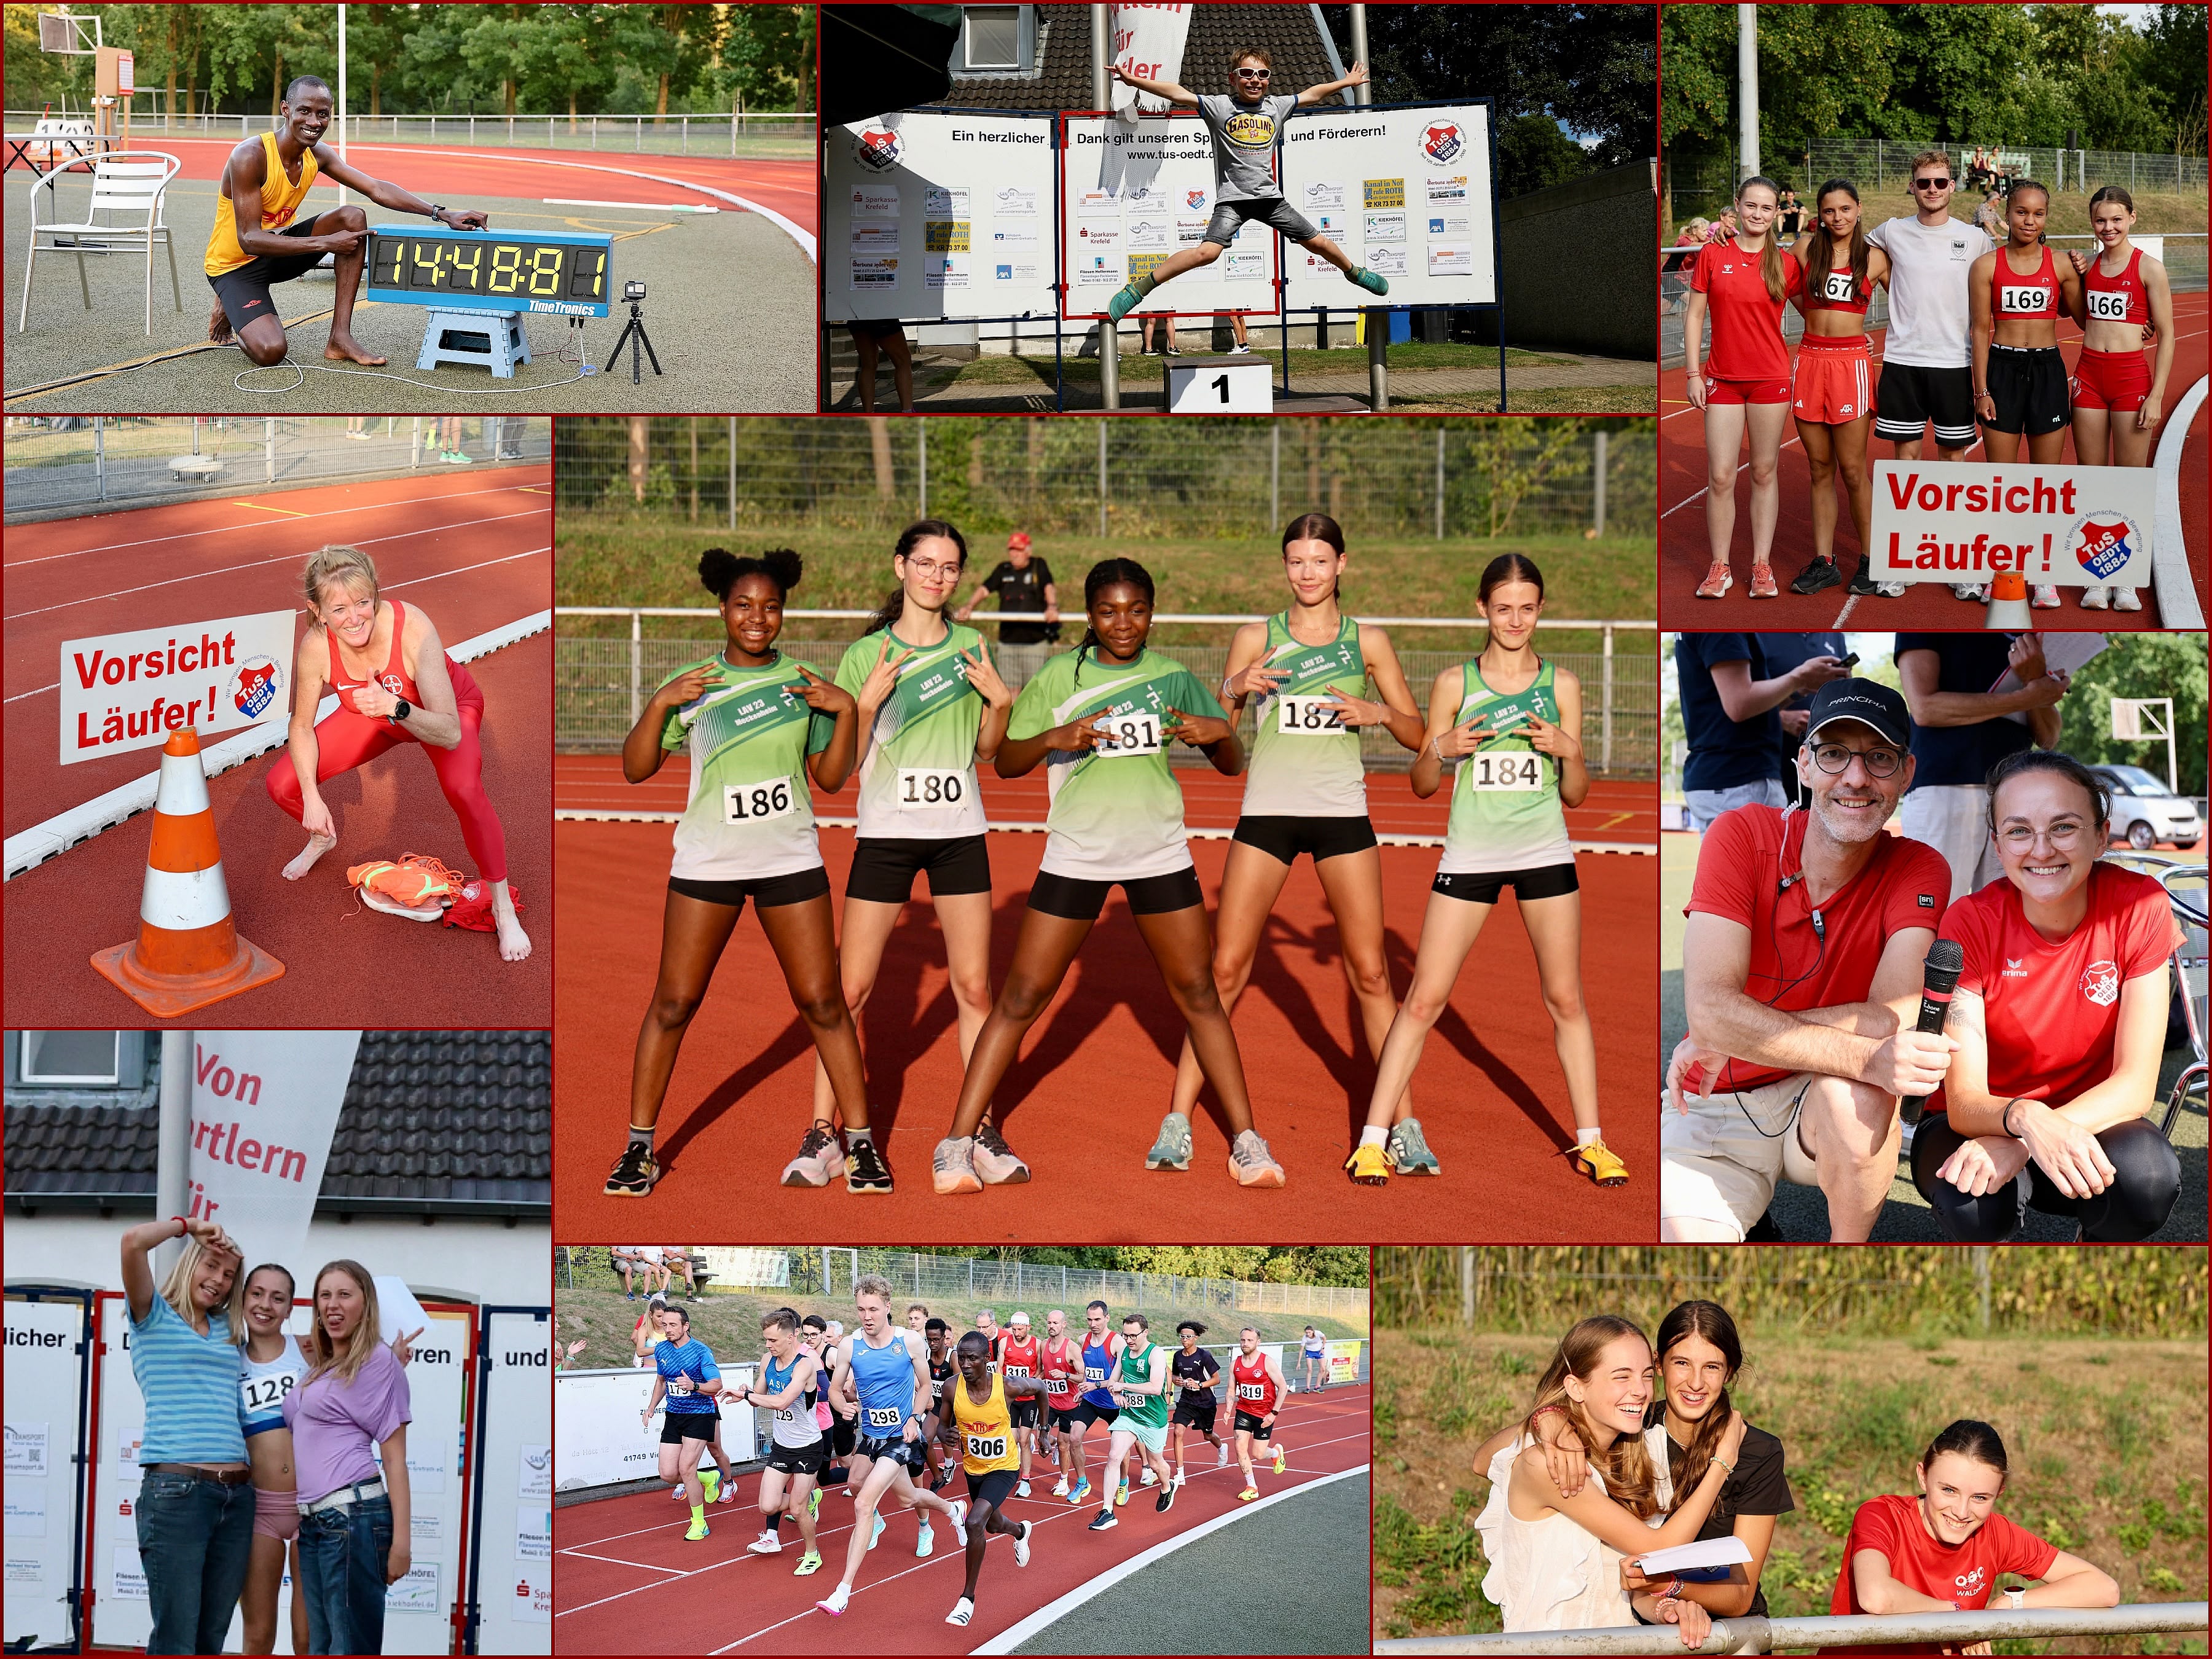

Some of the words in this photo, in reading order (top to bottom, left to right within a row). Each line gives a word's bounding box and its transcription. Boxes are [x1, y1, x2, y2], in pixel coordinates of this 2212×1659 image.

[1229, 118, 1273, 135] GASOLINE
[1291, 129, 1314, 142] und
[1319, 125, 1387, 140] Förderern!
[952, 130, 975, 142] Ein
[978, 130, 1046, 144] herzlicher
[1077, 133, 1109, 144] Dank
[1113, 133, 1134, 146] gilt
[1138, 134, 1190, 144] unseren
[1429, 132, 1449, 149] TuS
[1437, 138, 1454, 154] OEDT
[871, 144, 892, 160] OEDT
[876, 151, 896, 166] 1884
[1441, 144, 1459, 159] 1884
[1826, 277, 1853, 298] 67
[528, 300, 595, 316] TimeTronics
[2005, 290, 2045, 310] 169
[2090, 294, 2124, 316] 166
[1211, 374, 1230, 404] 1
[1886, 473, 2077, 516] Vorsicht
[2069, 517, 2085, 538] bringen
[2085, 509, 2122, 519] Menschen
[2129, 519, 2143, 552] Bewegung
[2082, 531, 2115, 558] TuS
[2092, 543, 2121, 567] OEDT
[2099, 552, 2127, 575] 1884
[74, 630, 235, 689] Vorsicht
[227, 665, 242, 687] bringen
[242, 654, 269, 665] Menschen
[274, 659, 284, 688] Bewegung
[238, 674, 264, 700] TuS
[246, 683, 268, 708] OEDT
[251, 691, 273, 714] 1884
[1827, 696, 1887, 712] PRINCIPIA
[1478, 758, 1539, 786] 184
[903, 775, 962, 803] 180
[731, 783, 788, 819] 186
[2001, 968, 2028, 978] erima
[2098, 981, 2114, 998] OEDT
[197, 1043, 262, 1107] Von
[4, 1327, 66, 1349] licher
[413, 1347, 451, 1365] ren
[505, 1347, 549, 1367] und
[1086, 1369, 1102, 1379] 217
[246, 1376, 294, 1408] 128
[1047, 1382, 1066, 1392] 316
[1242, 1386, 1261, 1398] 319
[871, 1410, 899, 1424] 298
[970, 1438, 1005, 1457] 306
[624, 1453, 646, 1462] 41749
[534, 1589, 551, 1599] Spa
[533, 1602, 551, 1611] Kre
